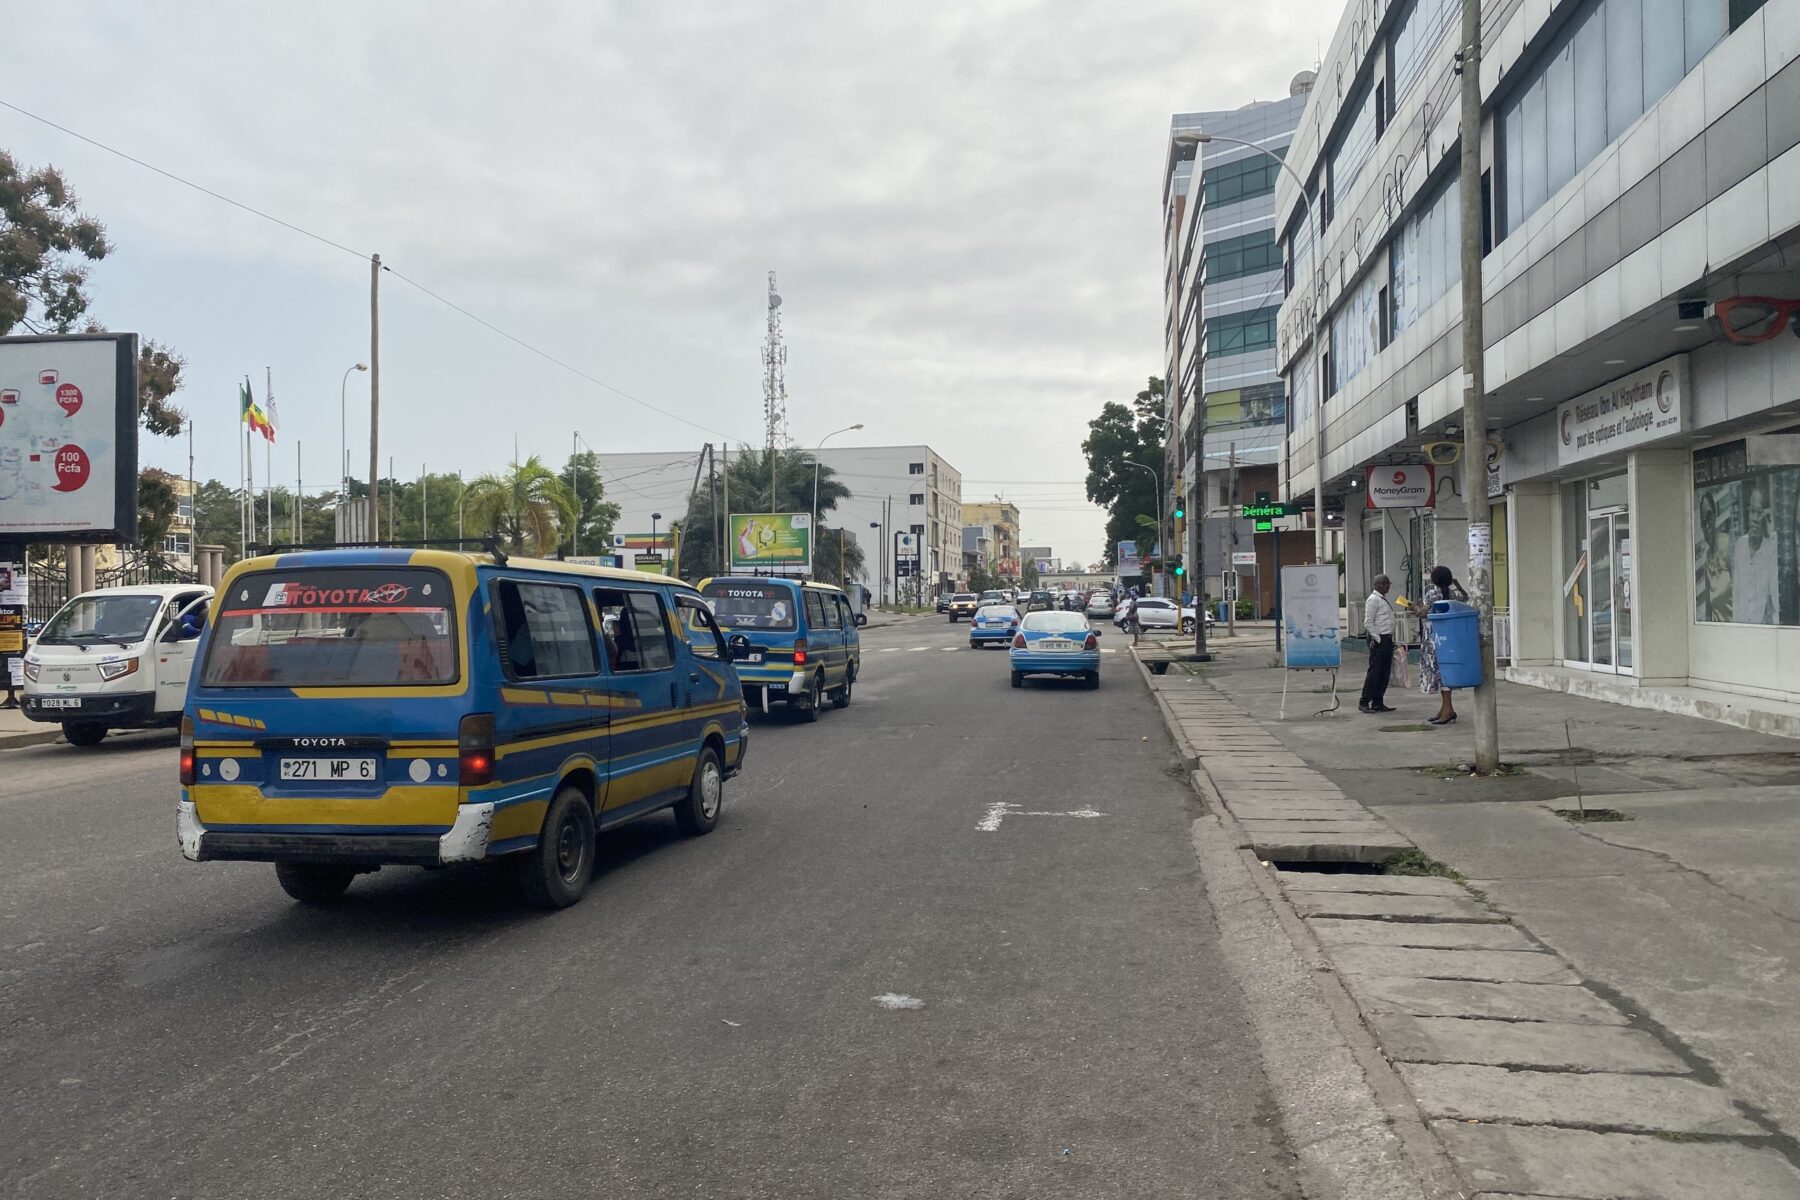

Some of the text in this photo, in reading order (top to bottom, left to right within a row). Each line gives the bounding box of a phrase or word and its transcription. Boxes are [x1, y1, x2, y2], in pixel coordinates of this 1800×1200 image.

[59, 396, 79, 404] FCFA
[1575, 403, 1599, 424] Réseau
[1620, 382, 1653, 410] Haytham
[1595, 423, 1616, 445] optiques
[60, 452, 80, 462] 100
[58, 463, 81, 473] Fcfa
[1373, 486, 1426, 496] MoneyGram
[291, 589, 371, 605] TOYOTA
[74, 699, 79, 707] 6
[293, 738, 346, 747] TOYOTA
[292, 760, 370, 778] 271 MP 6
